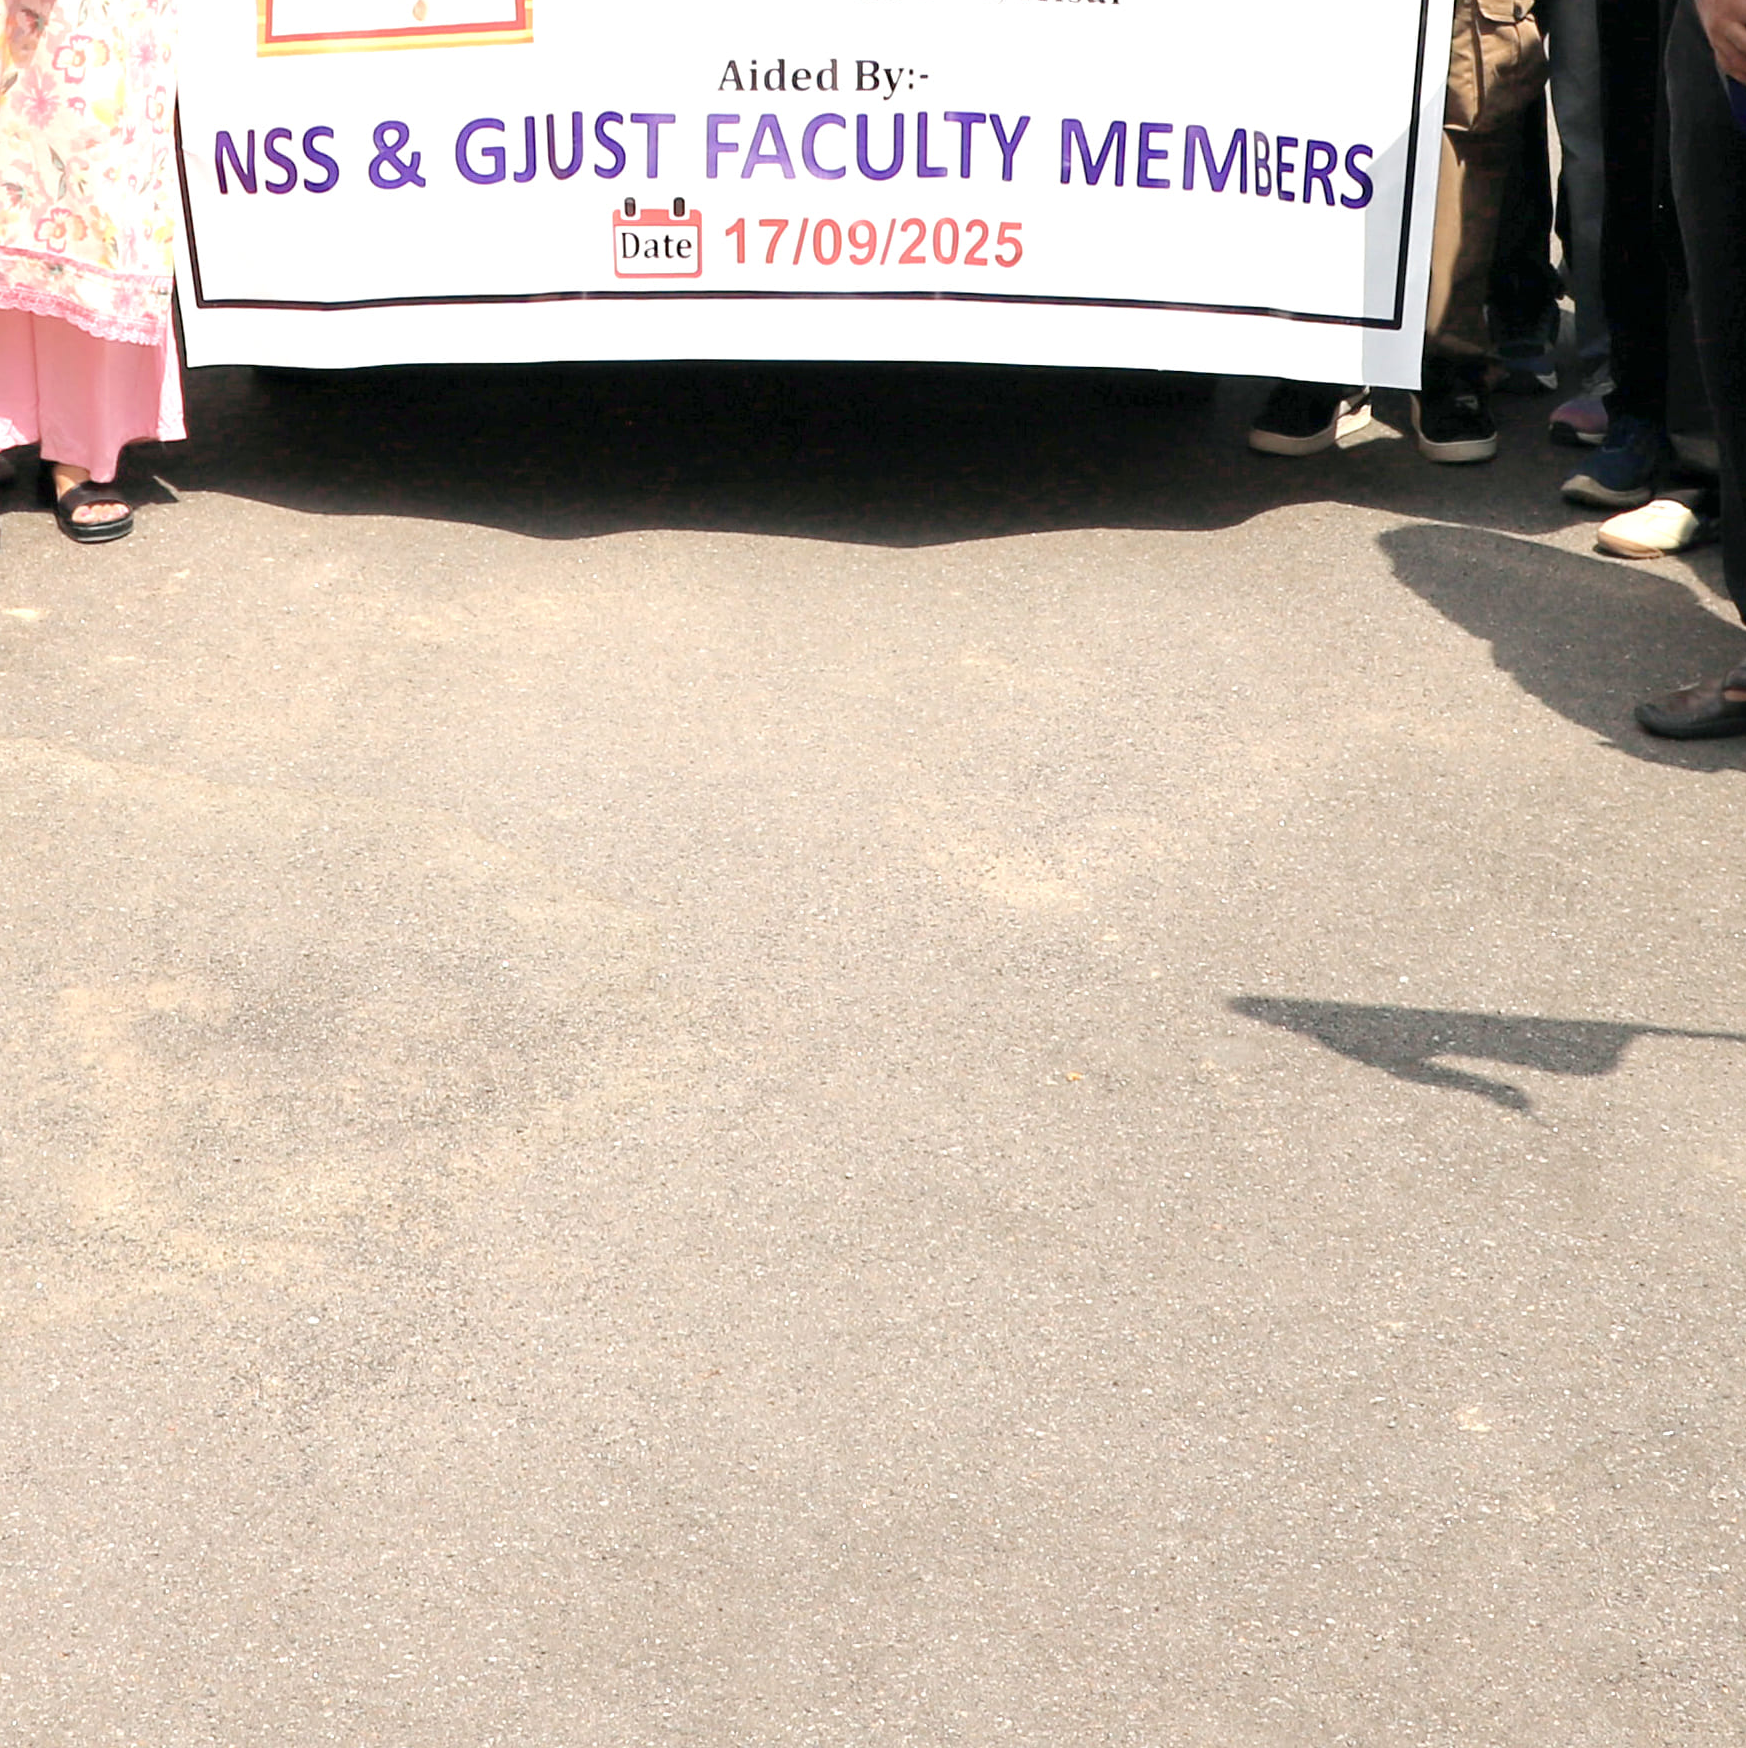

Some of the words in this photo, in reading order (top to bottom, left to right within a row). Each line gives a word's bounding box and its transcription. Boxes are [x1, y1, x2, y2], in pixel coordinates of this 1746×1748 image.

[717, 57, 840, 92] Aided
[854, 59, 930, 102] By:-
[213, 124, 342, 196] NSS
[367, 119, 427, 191] &
[454, 110, 677, 186] GJUST
[705, 106, 1032, 183] FACULTY
[1059, 117, 1376, 210] MEMBERS
[620, 232, 693, 259] Date
[724, 216, 1024, 269] 17/09/2025
